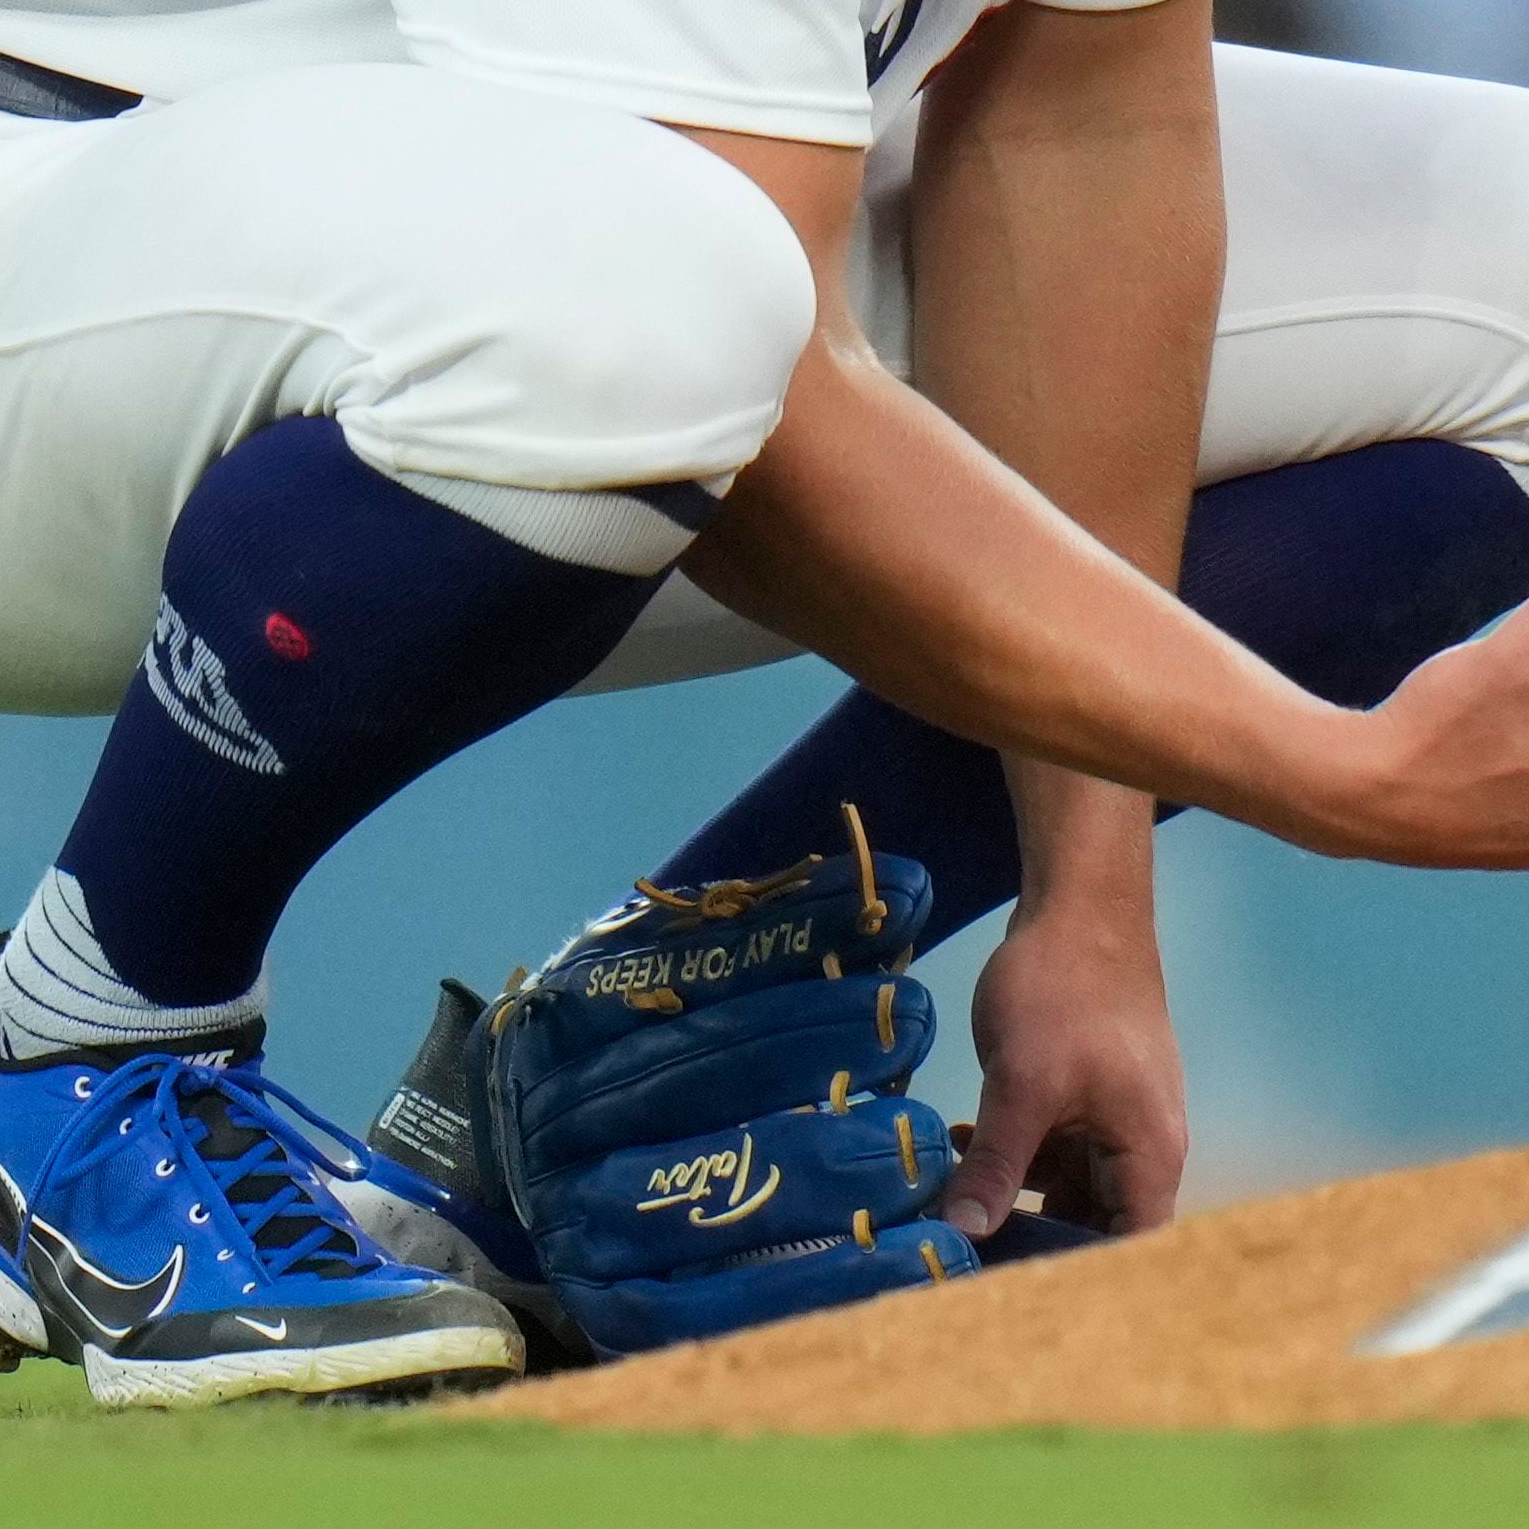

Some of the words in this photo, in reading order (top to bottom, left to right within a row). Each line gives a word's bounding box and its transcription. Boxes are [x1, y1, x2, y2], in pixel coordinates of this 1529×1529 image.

[681, 946, 738, 982] FOR
[743, 918, 813, 968] PLAY
[586, 951, 674, 997] KEEPS
[175, 1049, 235, 1070] IKE
[636, 1132, 781, 1227] Tater
